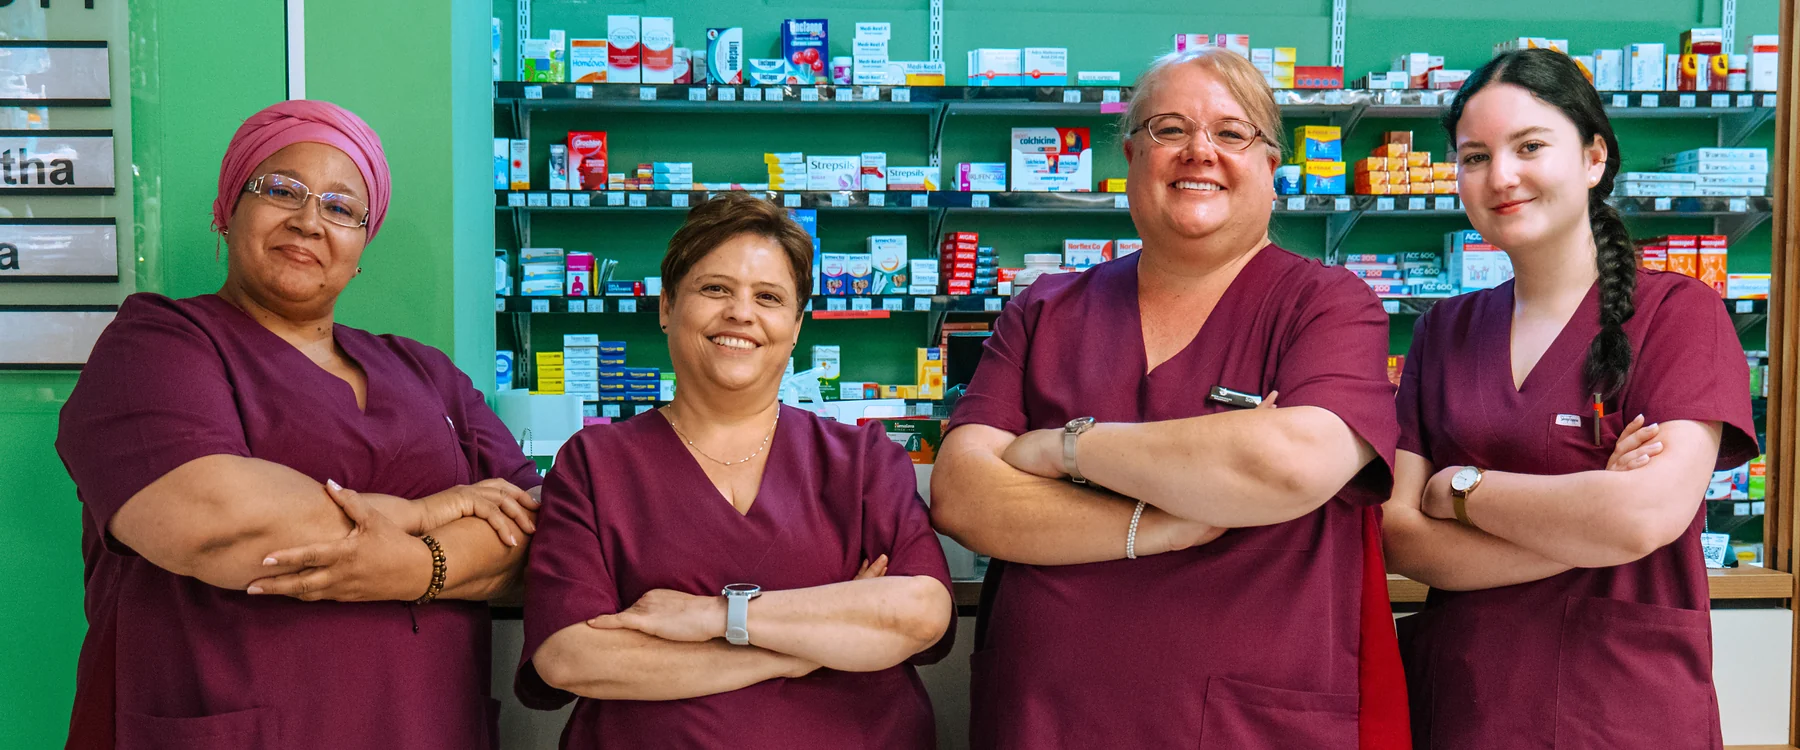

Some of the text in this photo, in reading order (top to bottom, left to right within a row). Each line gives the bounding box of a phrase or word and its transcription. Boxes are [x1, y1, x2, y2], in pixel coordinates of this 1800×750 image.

[1020, 136, 1056, 145] colchicine
[811, 160, 855, 172] Strepsils
[890, 169, 924, 179] Strepsils
